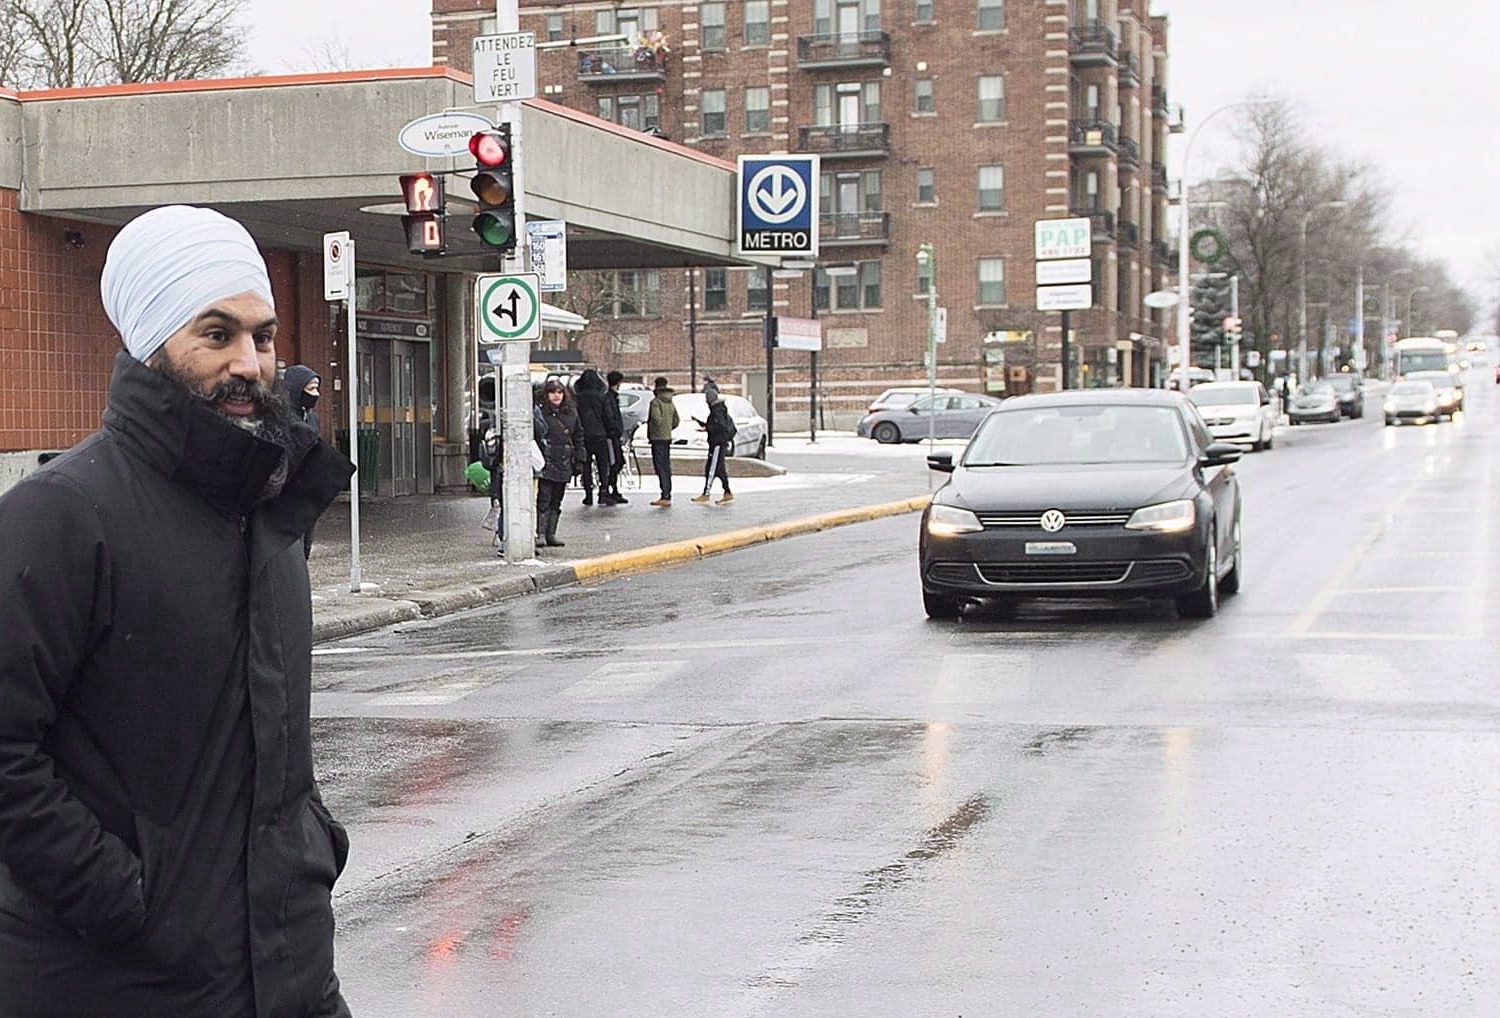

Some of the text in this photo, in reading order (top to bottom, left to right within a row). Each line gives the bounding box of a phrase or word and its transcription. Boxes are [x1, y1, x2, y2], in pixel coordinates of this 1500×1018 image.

[474, 35, 534, 53] ATTENDEZ
[496, 53, 511, 67] LE
[492, 68, 516, 82] FEU
[489, 82, 519, 97] VERT
[424, 129, 474, 141] Wiseman
[745, 231, 808, 249] METRO
[1041, 228, 1086, 248] PAP
